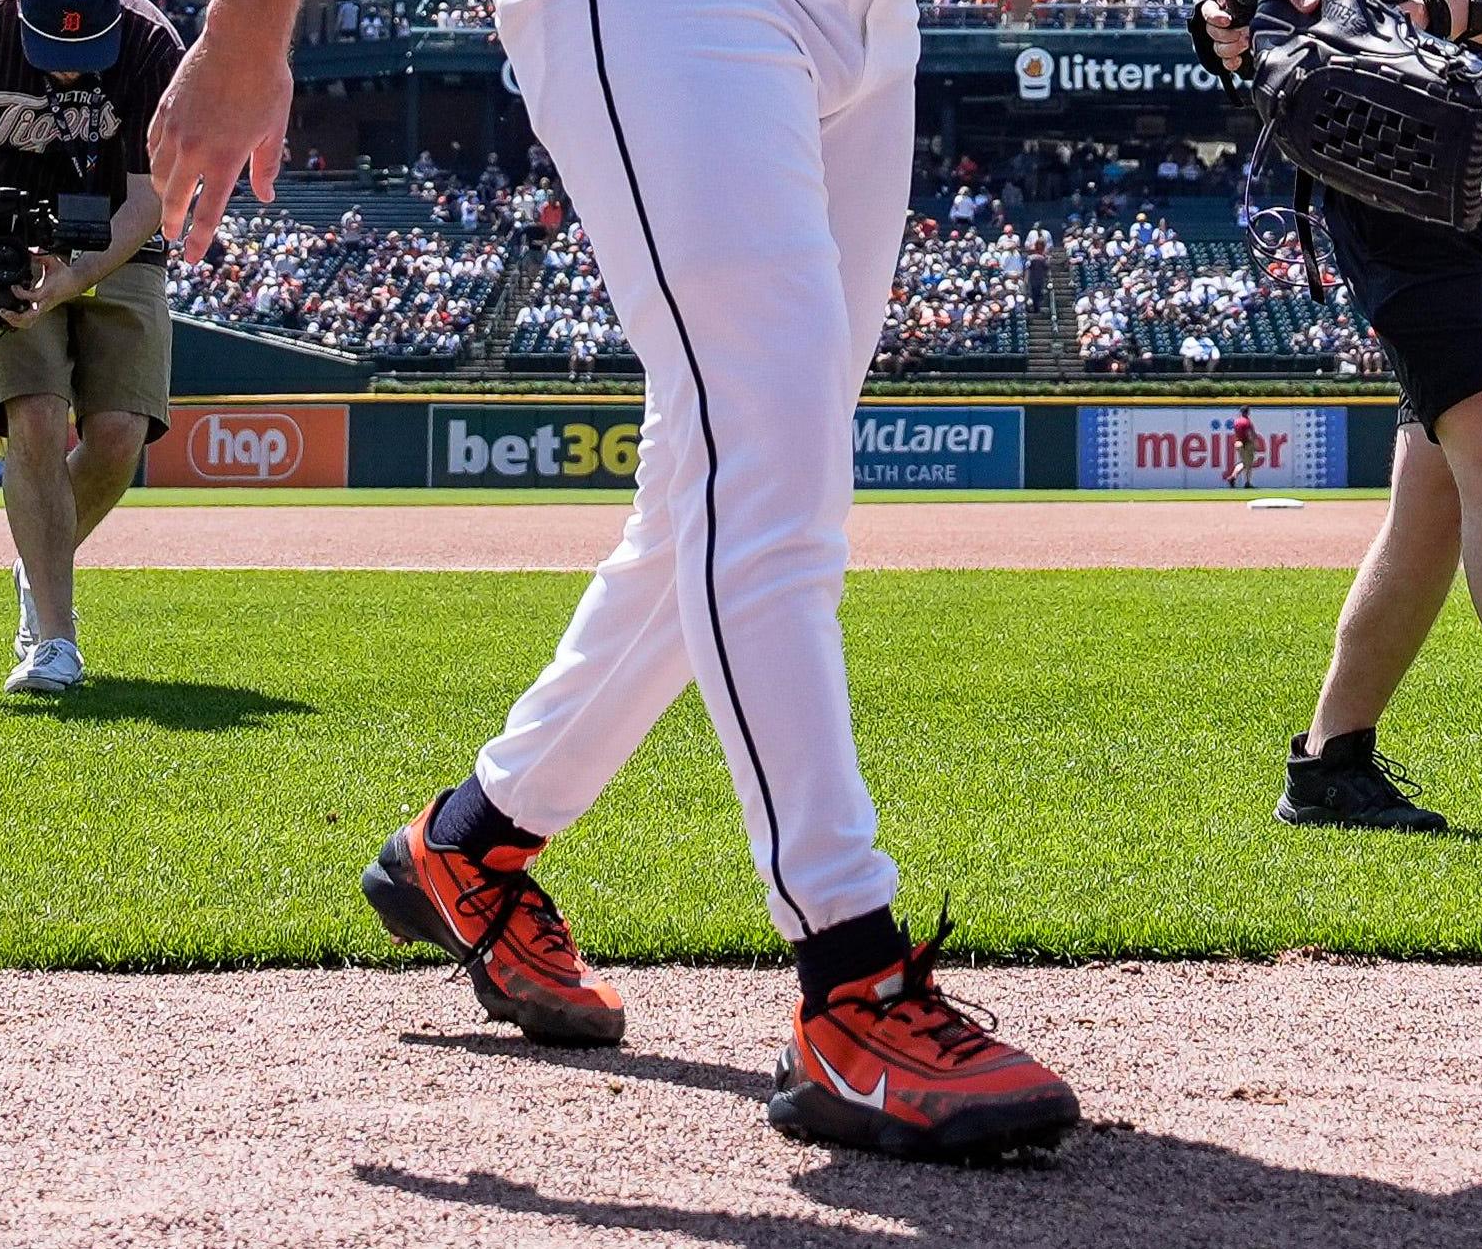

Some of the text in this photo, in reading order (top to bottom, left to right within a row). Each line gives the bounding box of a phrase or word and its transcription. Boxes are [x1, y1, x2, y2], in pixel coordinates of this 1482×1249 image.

[207, 414, 288, 479] hap
[446, 419, 640, 476] bet36
[853, 418, 995, 453] McLaren
[1136, 419, 1289, 483] meijer
[854, 464, 958, 483] ALTH CARE
